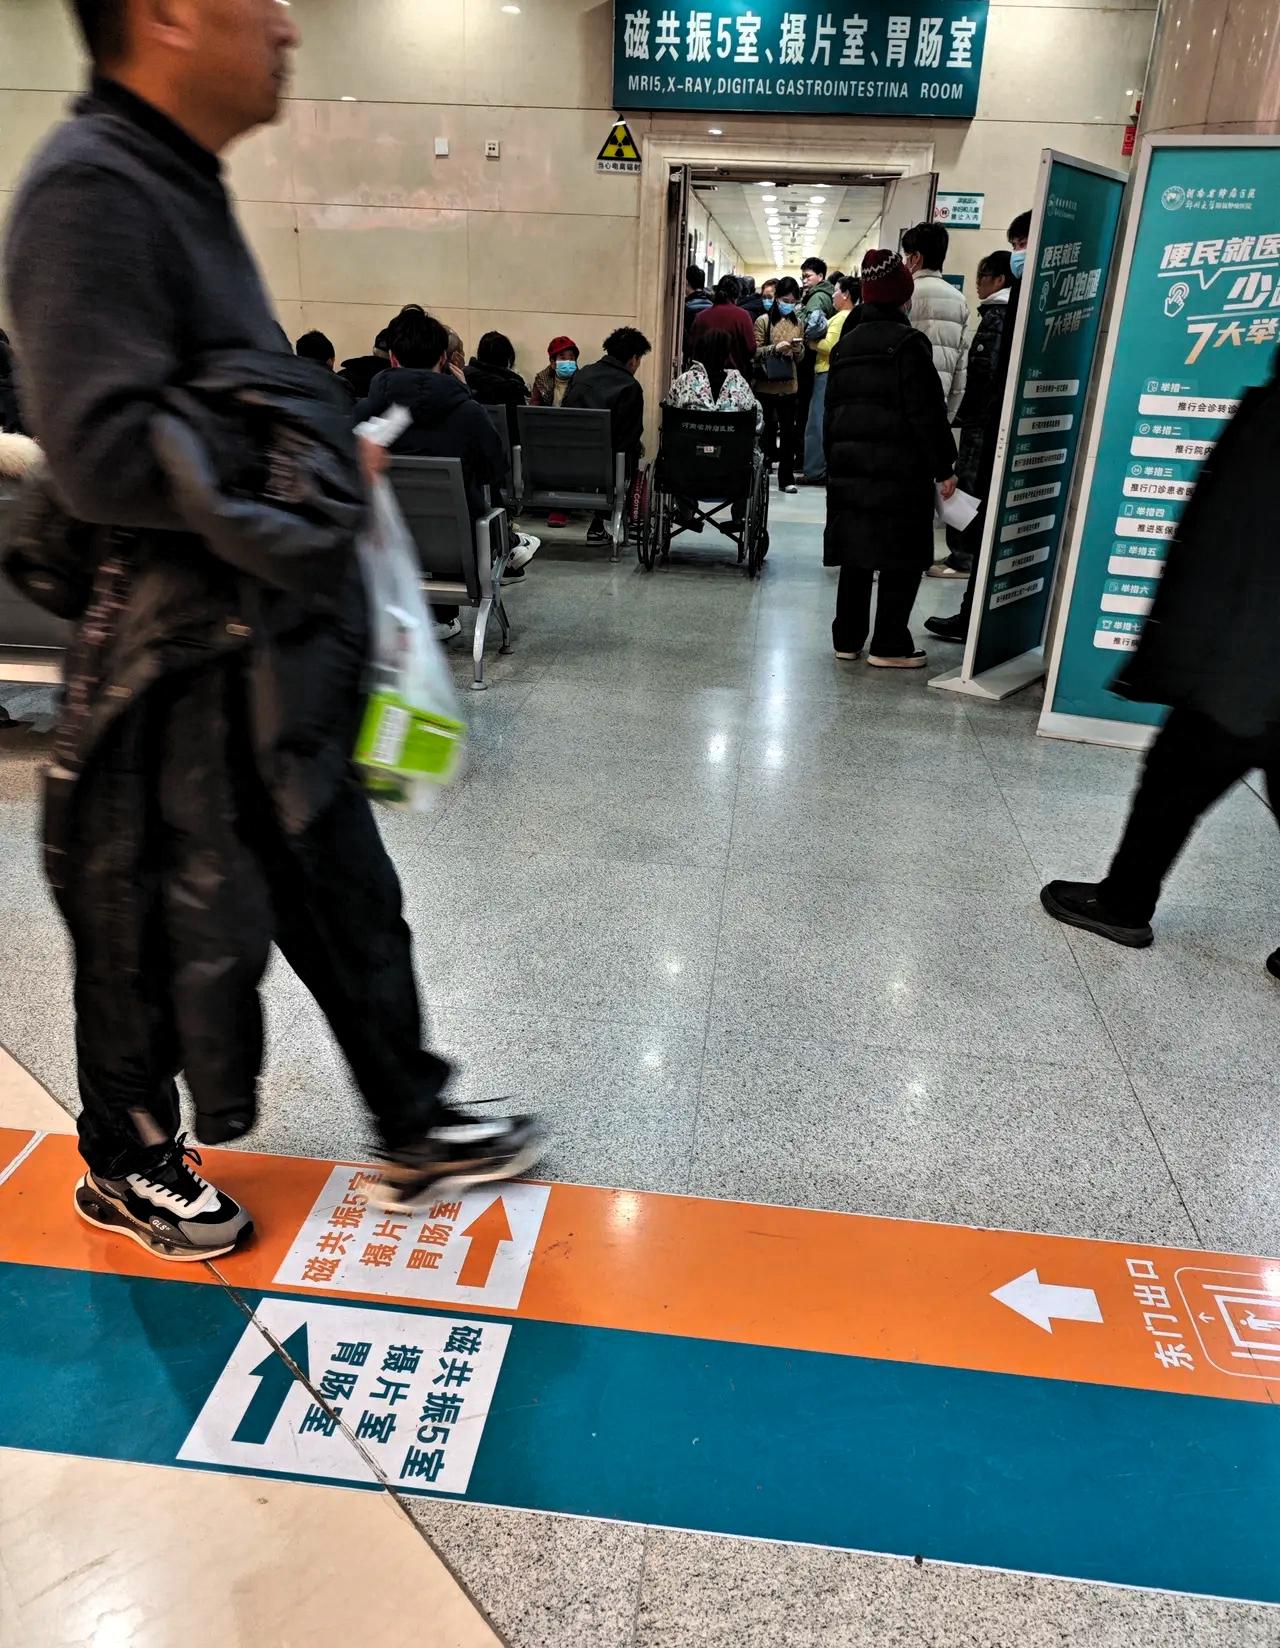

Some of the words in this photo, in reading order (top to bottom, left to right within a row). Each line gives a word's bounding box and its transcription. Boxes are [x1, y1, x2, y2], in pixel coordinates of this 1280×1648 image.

[624, 9, 977, 69] 磁共振5室、摄片室、胃肠室
[776, 79, 909, 99] GASTROINTESTINA
[920, 83, 964, 101] ROOM
[1041, 242, 1083, 270] 便民就医
[1160, 232, 1280, 270] 便民就医
[1057, 268, 1101, 306] 少跑腿
[1184, 317, 1280, 365] 7大举
[1160, 382, 1191, 393] 举措一
[1152, 424, 1182, 436] 举措二
[1143, 466, 1174, 477] 举措三
[1136, 506, 1165, 518] 举措四
[1128, 545, 1157, 557] 举措五
[1120, 583, 1150, 595] 举措六
[301, 1171, 383, 1283] 磁共振5室
[406, 1200, 463, 1270] 胃肠室
[1125, 1258, 1196, 1371] 东门出口
[298, 1341, 373, 1437] 胃肠室
[355, 1344, 424, 1443] 摄片室
[400, 1325, 483, 1482] 磁共振5室
